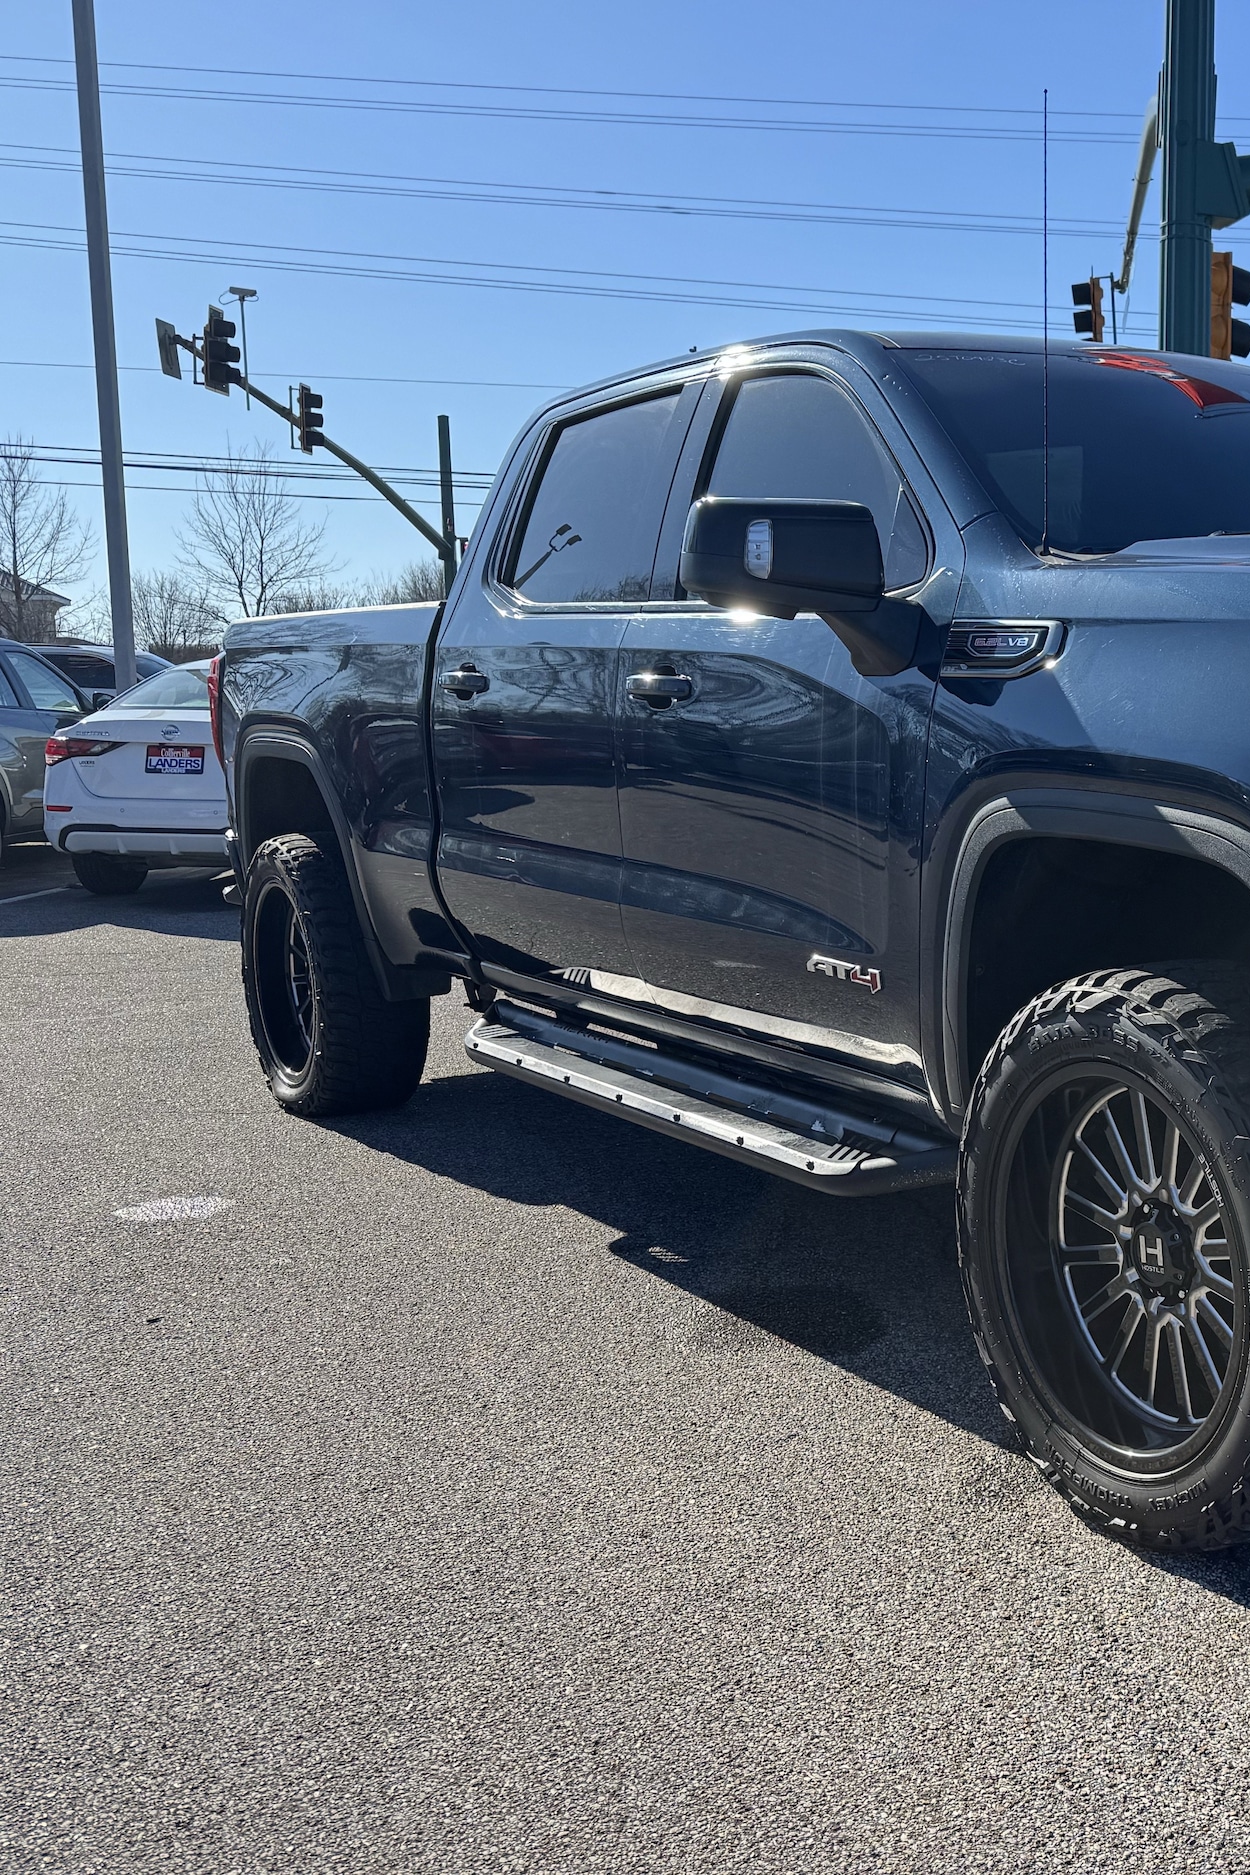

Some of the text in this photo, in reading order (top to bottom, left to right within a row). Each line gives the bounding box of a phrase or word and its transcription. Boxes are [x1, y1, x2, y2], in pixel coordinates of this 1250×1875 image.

[148, 758, 200, 769] LANDERS
[160, 747, 191, 758] Collierville
[806, 954, 881, 994] AT4
[1198, 1152, 1225, 1208] HOSTILE
